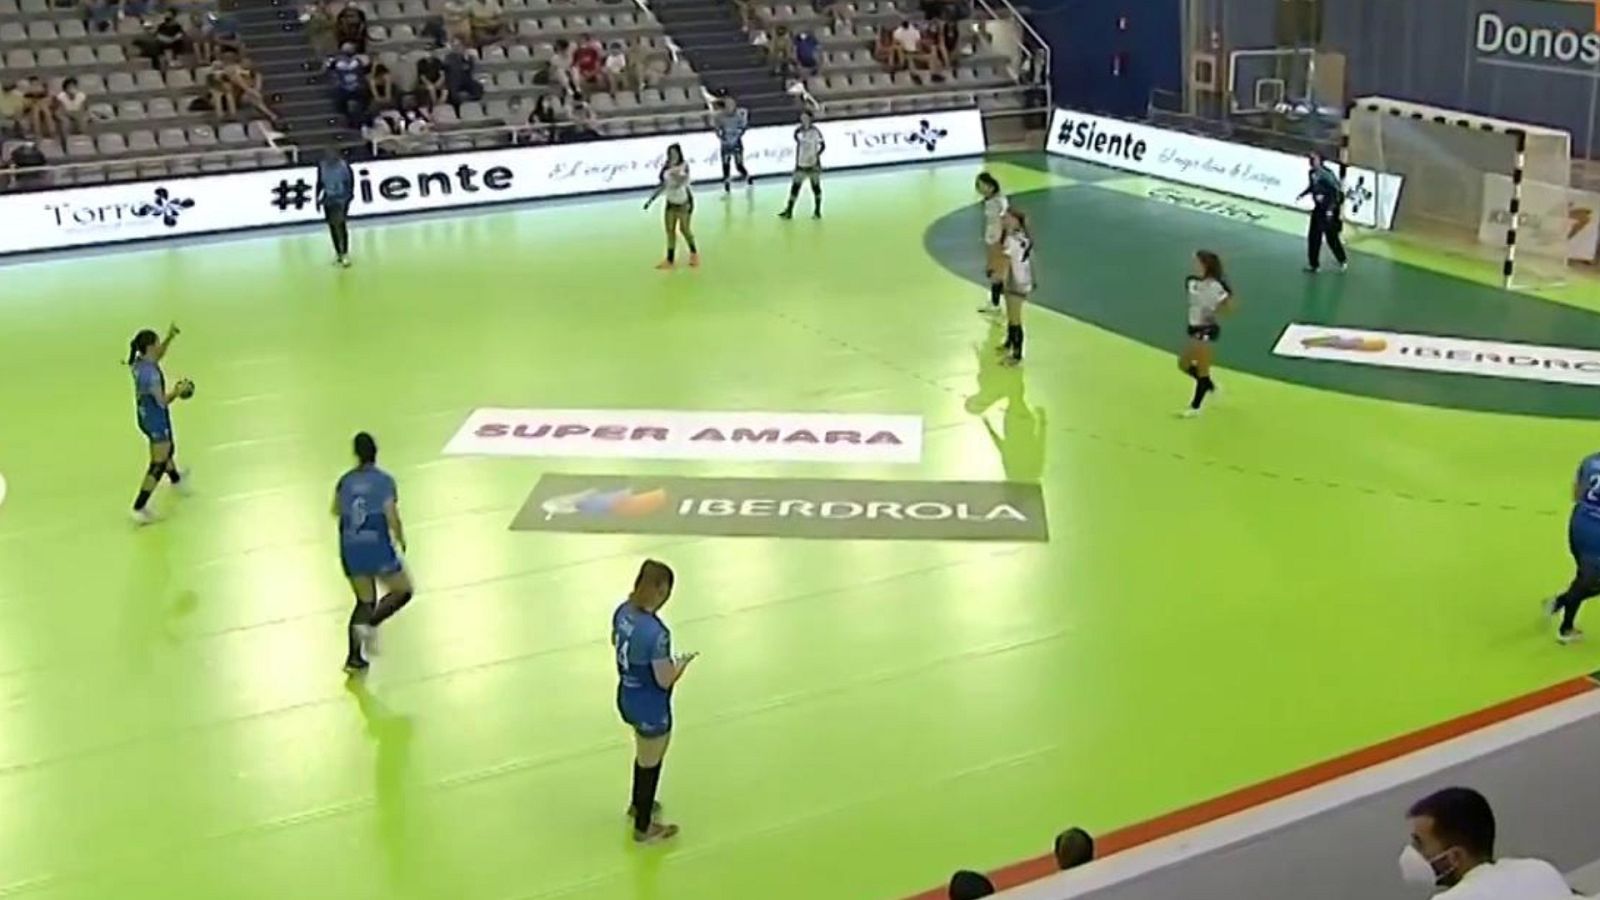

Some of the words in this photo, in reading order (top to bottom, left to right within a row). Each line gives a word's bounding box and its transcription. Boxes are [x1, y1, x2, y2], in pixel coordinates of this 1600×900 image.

[1477, 13, 1600, 63] Donos
[1058, 118, 1147, 162] #Siente
[270, 163, 514, 210] #iente
[474, 423, 670, 442] SUPER
[690, 427, 904, 446] AMARA
[678, 497, 1028, 522] IBERDROLA
